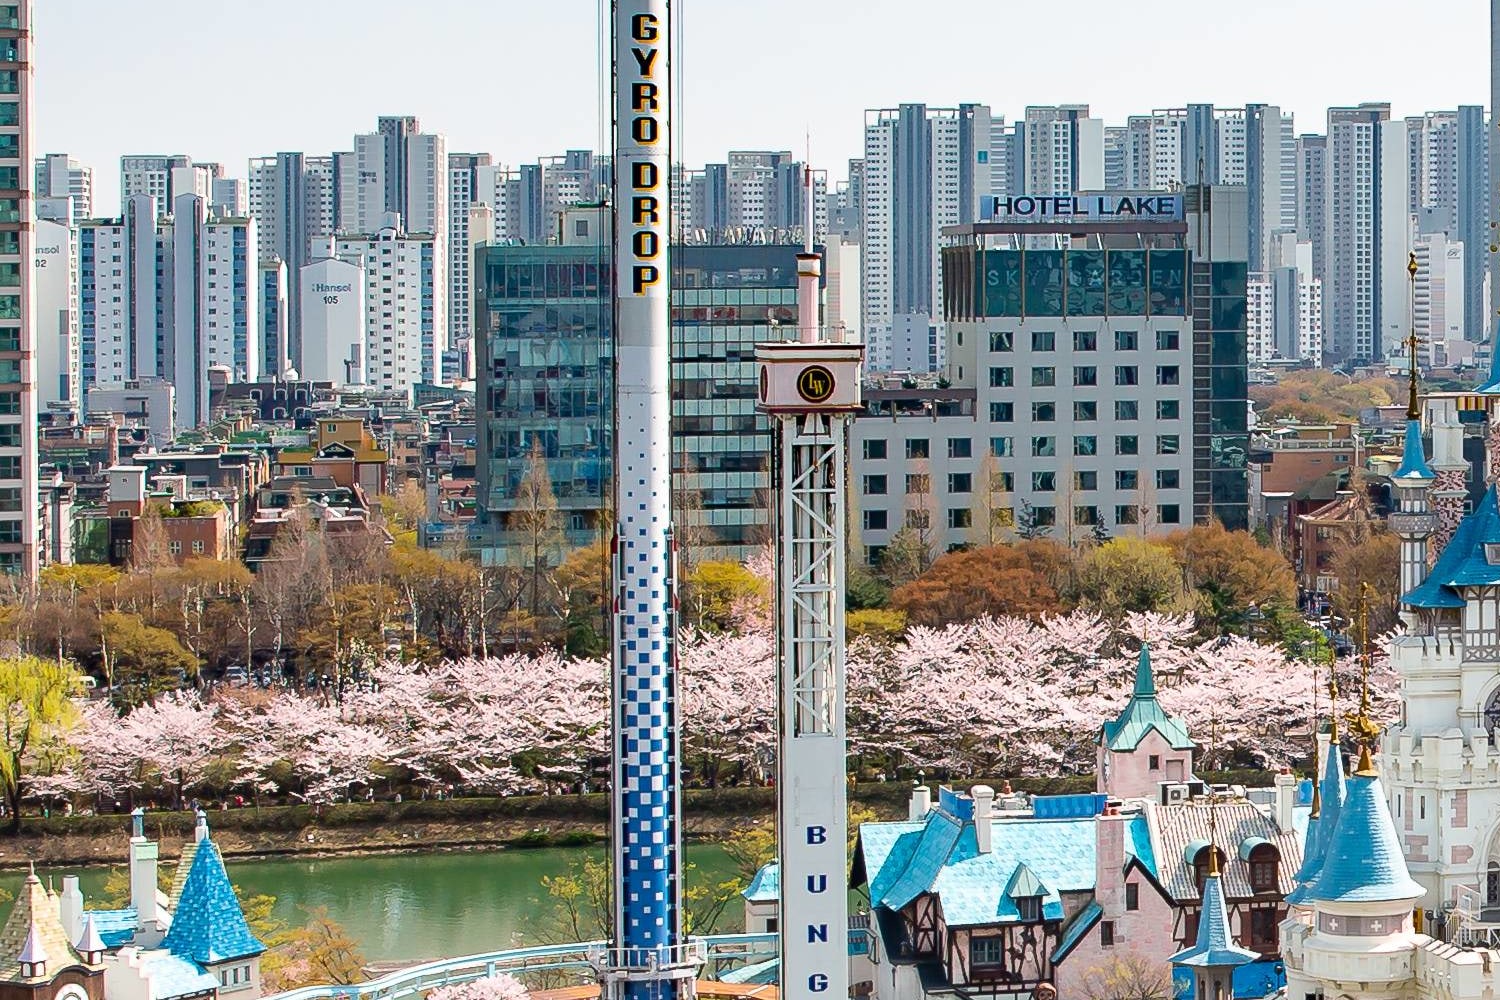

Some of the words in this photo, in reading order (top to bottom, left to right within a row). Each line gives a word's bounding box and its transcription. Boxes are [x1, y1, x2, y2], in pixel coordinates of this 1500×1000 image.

[631, 13, 660, 145] GYRO
[993, 196, 1089, 216] HOTEL
[1097, 196, 1175, 216] LAKE
[631, 161, 660, 296] DROP
[987, 269, 1040, 287] SKY
[323, 295, 339, 305] 105
